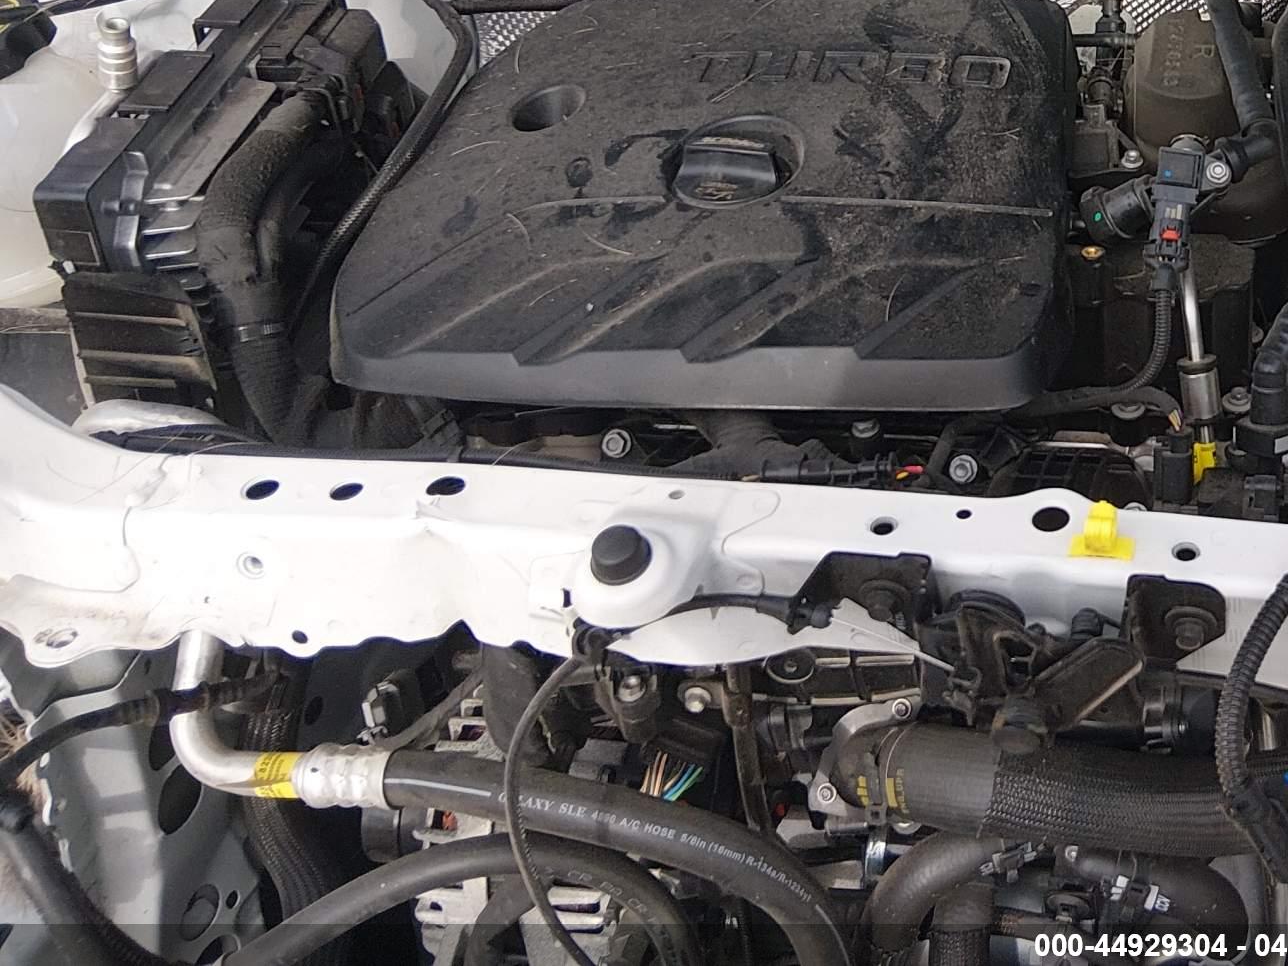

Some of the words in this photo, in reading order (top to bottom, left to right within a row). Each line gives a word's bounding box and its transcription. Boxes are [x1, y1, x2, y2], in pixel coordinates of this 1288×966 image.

[691, 50, 1011, 89] TURBO
[558, 802, 587, 818] SLE
[619, 817, 641, 830] A/C
[644, 823, 676, 840] HOSE
[707, 841, 746, 864] (16mm)
